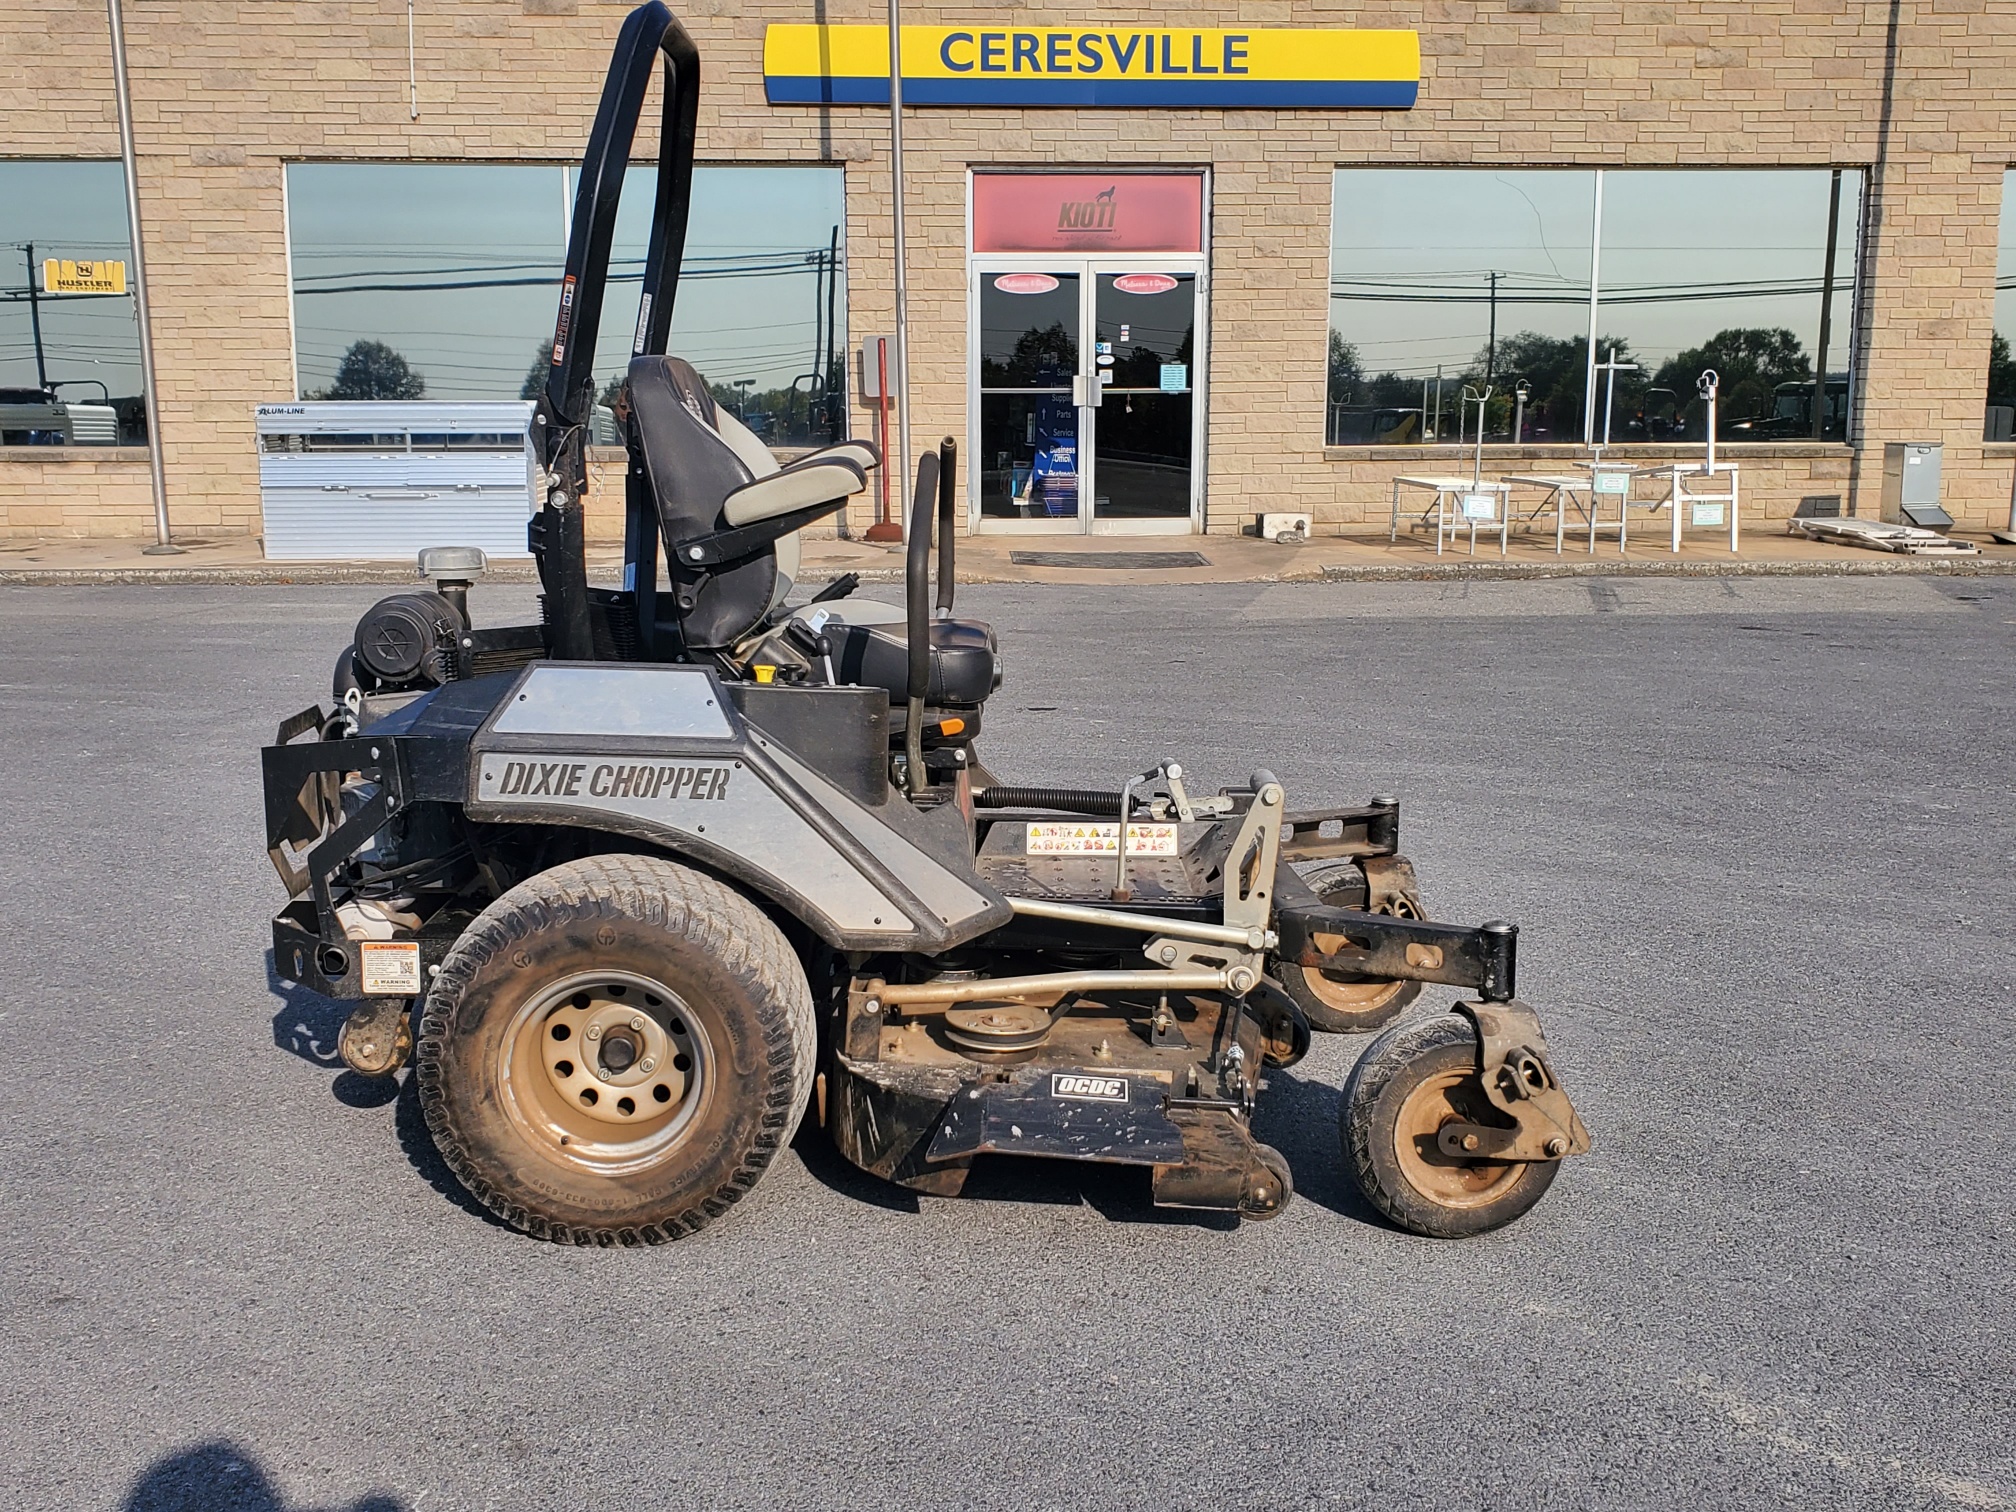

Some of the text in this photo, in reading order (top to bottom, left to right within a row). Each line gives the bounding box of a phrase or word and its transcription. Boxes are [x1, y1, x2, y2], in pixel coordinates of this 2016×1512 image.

[940, 32, 1249, 74] CERESVILLE
[1058, 201, 1117, 228] KIOTI
[1056, 368, 1072, 377] Sales
[1056, 409, 1072, 418] Parts
[1052, 428, 1074, 437] Service
[1050, 445, 1076, 454] Business
[499, 762, 731, 801] DIXIE CHOPPER
[1058, 1077, 1121, 1096] OCDC
[708, 1134, 724, 1154] FOR
[668, 1157, 708, 1190] SERVICE
[635, 1185, 662, 1202] CALL
